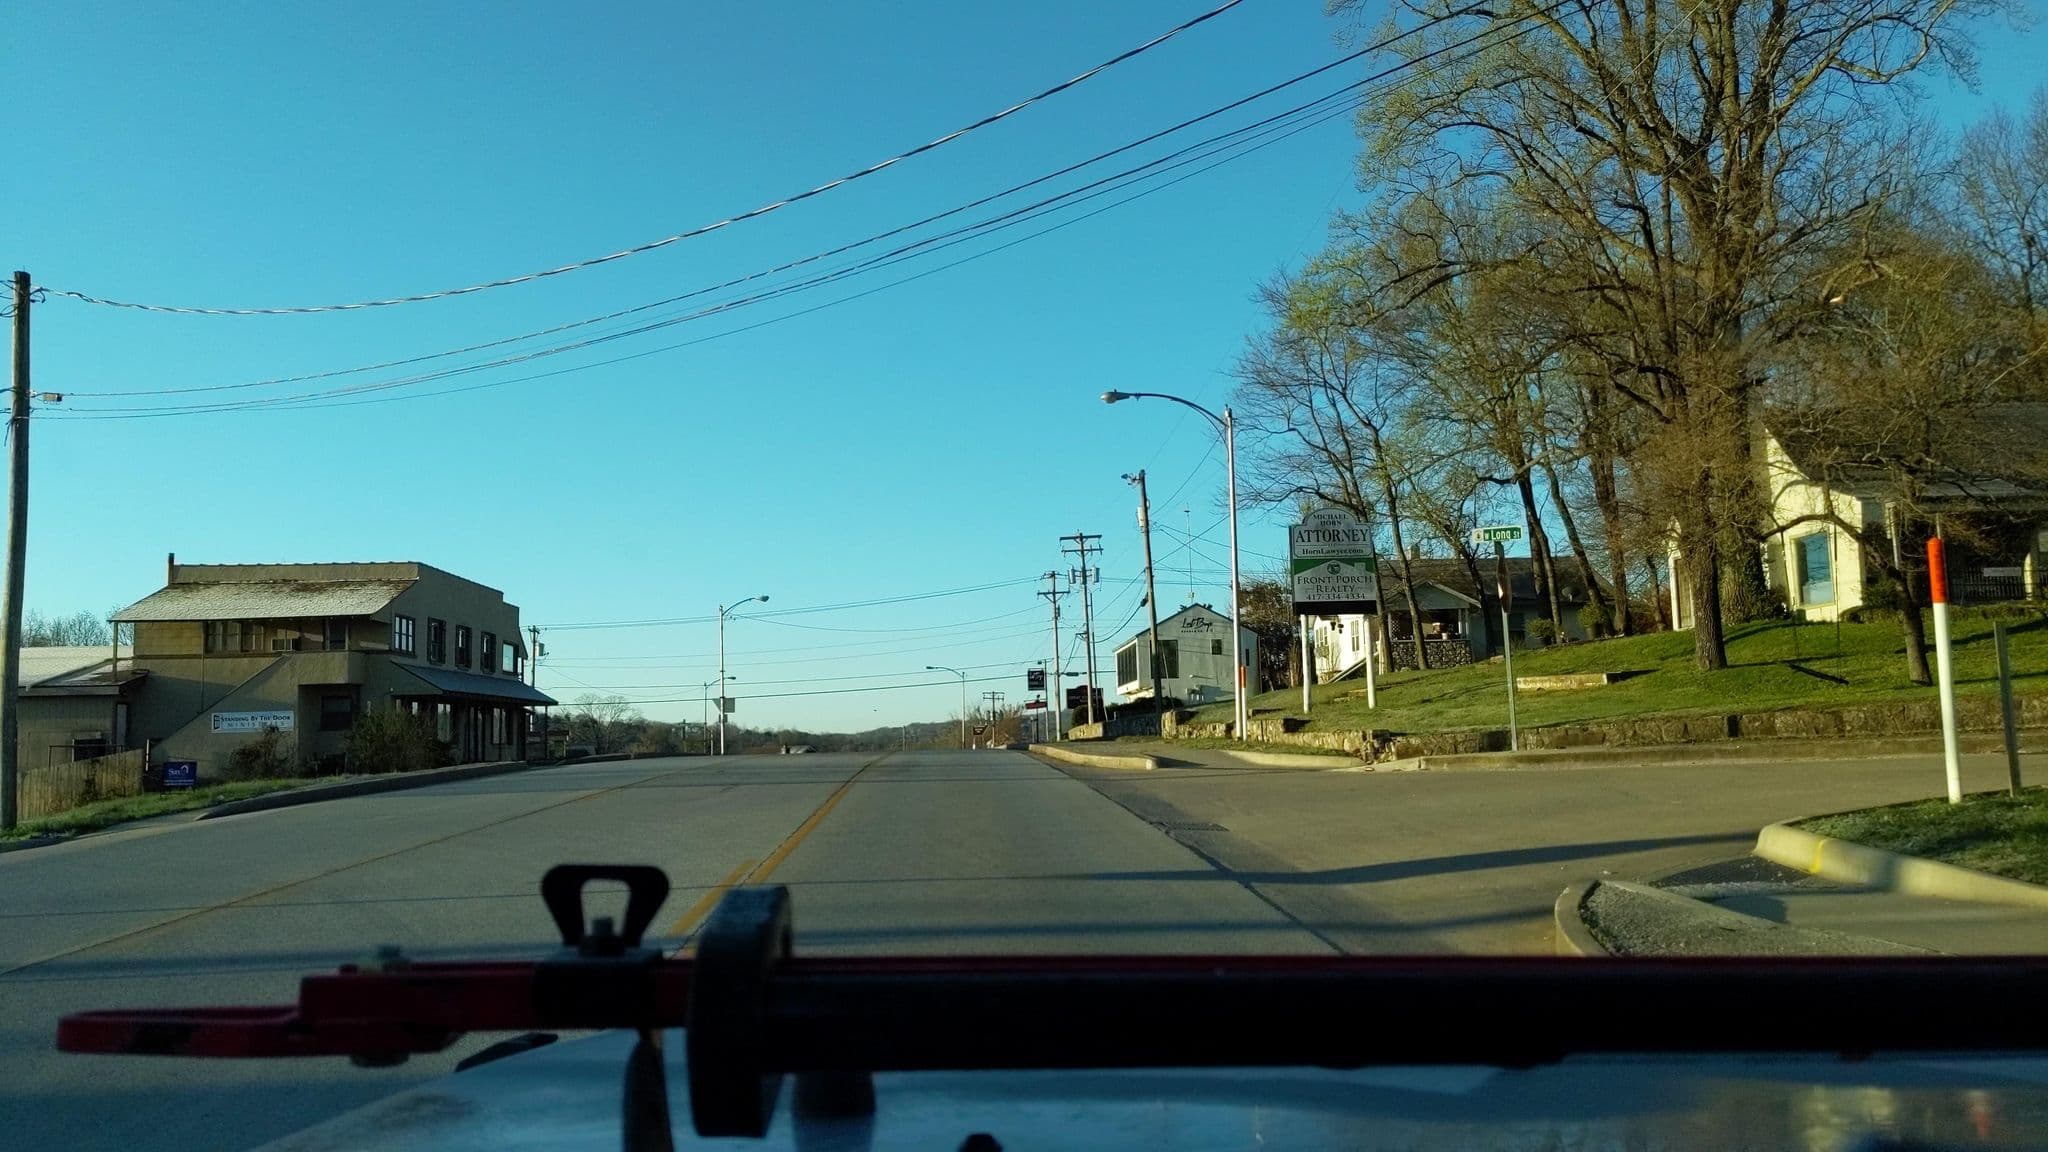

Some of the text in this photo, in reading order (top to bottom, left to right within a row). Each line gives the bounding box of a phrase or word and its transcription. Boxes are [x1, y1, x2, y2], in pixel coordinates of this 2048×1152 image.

[1296, 529, 1368, 542] ATTORNEY
[1491, 530, 1511, 540] Long
[1302, 548, 1364, 556] HornLawyer.com
[1297, 575, 1373, 584] FRONT PORCH
[1316, 584, 1355, 593] REALTY
